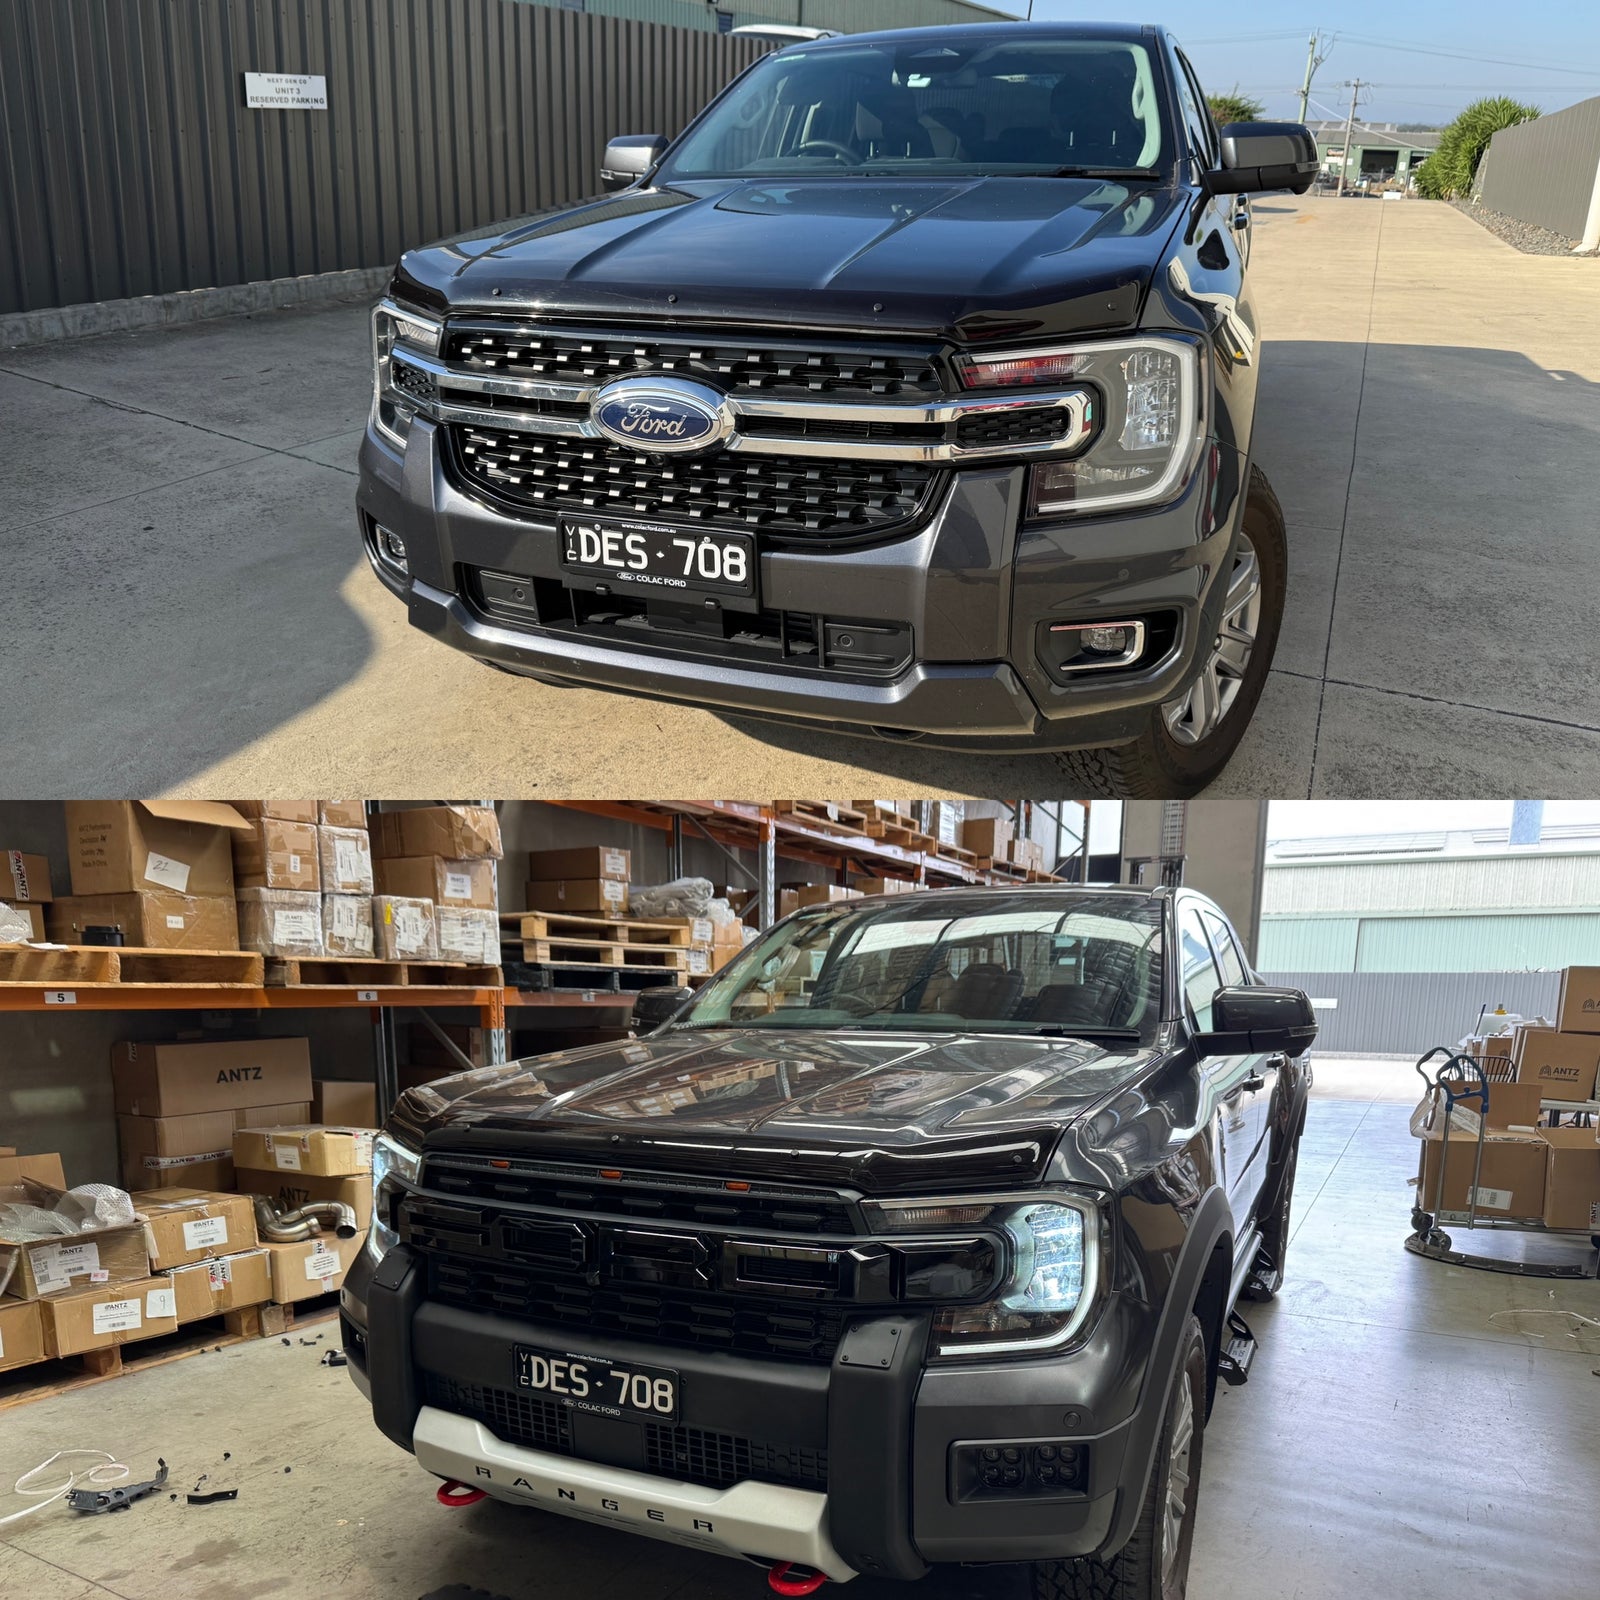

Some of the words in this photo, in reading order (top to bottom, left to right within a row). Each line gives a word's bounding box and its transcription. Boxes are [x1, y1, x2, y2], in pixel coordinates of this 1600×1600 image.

[620, 402, 687, 436] Ford
[565, 526, 577, 561] VIC
[579, 527, 648, 570] DES
[673, 538, 747, 582] 708
[636, 575, 662, 584] COLAC
[664, 578, 687, 587] FORD
[20, 872, 28, 898] ANTZ
[57, 993, 65, 1002] 5
[365, 992, 371, 1000] 6
[216, 1066, 262, 1084] ANTZ
[1553, 1067, 1580, 1076] ANTZ
[278, 1185, 310, 1203] ANTZ
[62, 1247, 83, 1255] ANTZ
[520, 1353, 529, 1386] VIC
[530, 1355, 589, 1397] DES
[610, 1370, 674, 1413] 708
[577, 1401, 600, 1412] COLAC
[601, 1406, 621, 1417] FORD
[475, 1465, 714, 1533] RANGER
